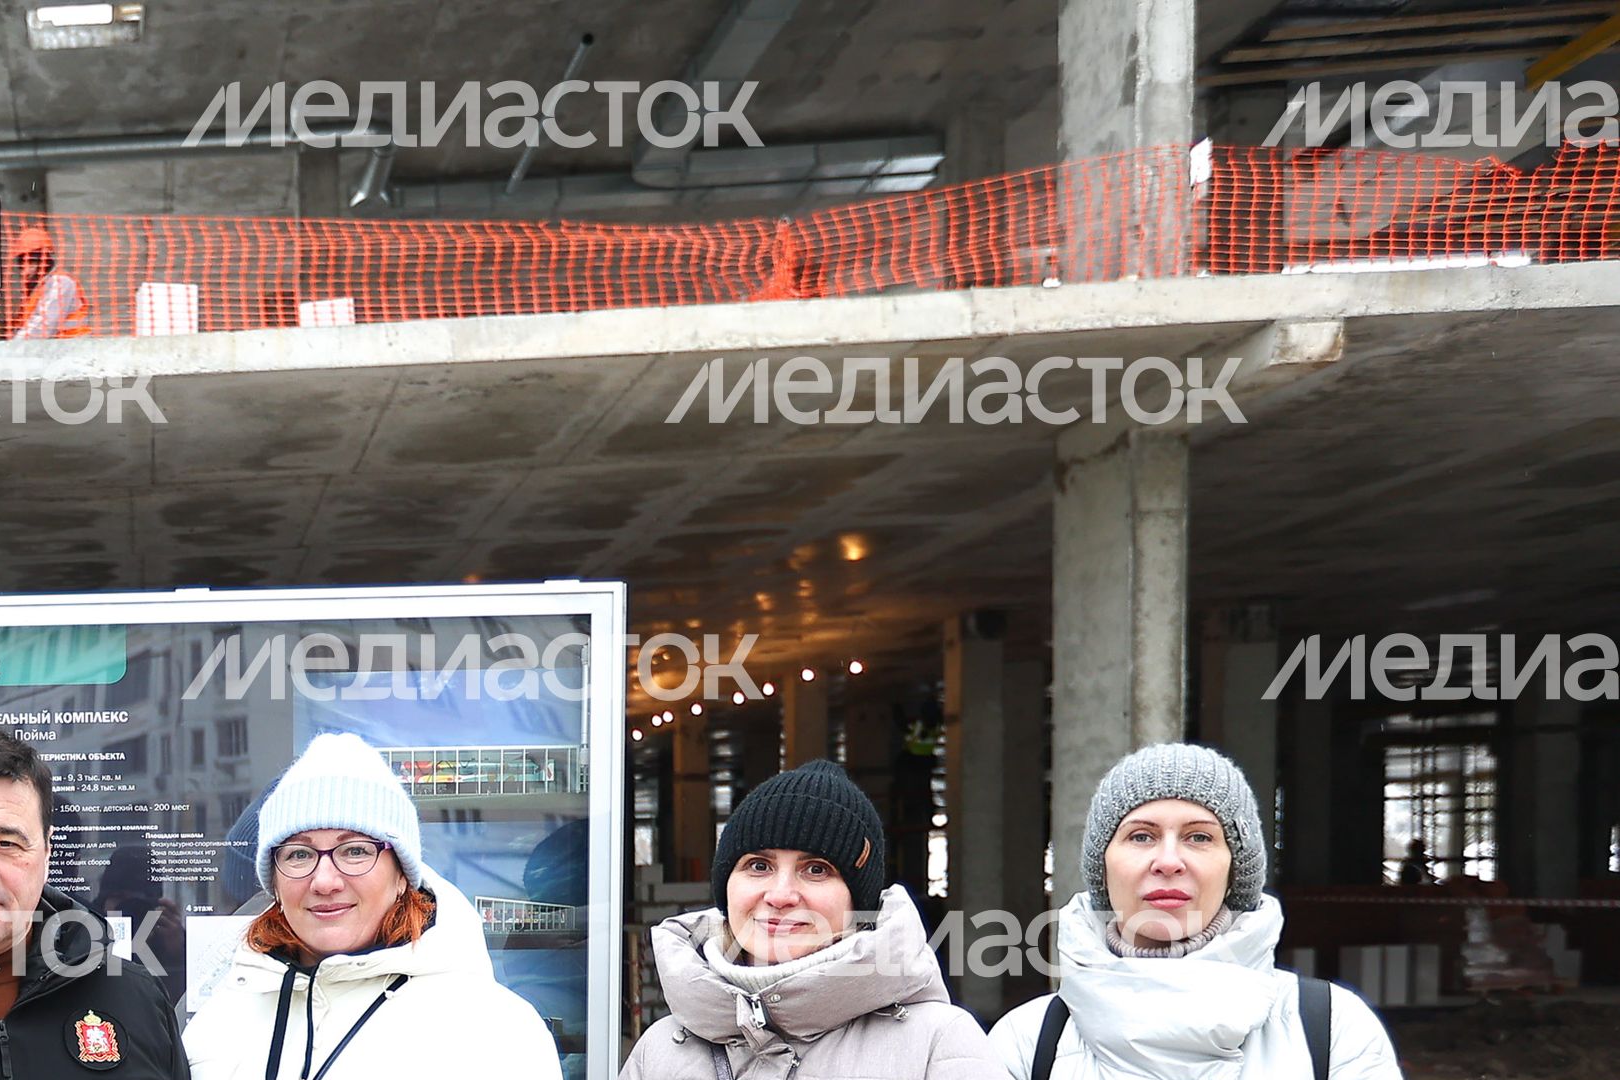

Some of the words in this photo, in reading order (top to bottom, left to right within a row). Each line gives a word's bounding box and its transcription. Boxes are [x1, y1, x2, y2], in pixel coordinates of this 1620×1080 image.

[55, 711, 129, 724] КОМПЛЕКС
[15, 729, 56, 741] Пойма
[38, 753, 87, 761] ТЕРИСТИКА
[88, 752, 126, 760] ОБЪЕКТА
[103, 804, 133, 812] детский
[154, 803, 170, 811] 200
[185, 904, 191, 912] 4
